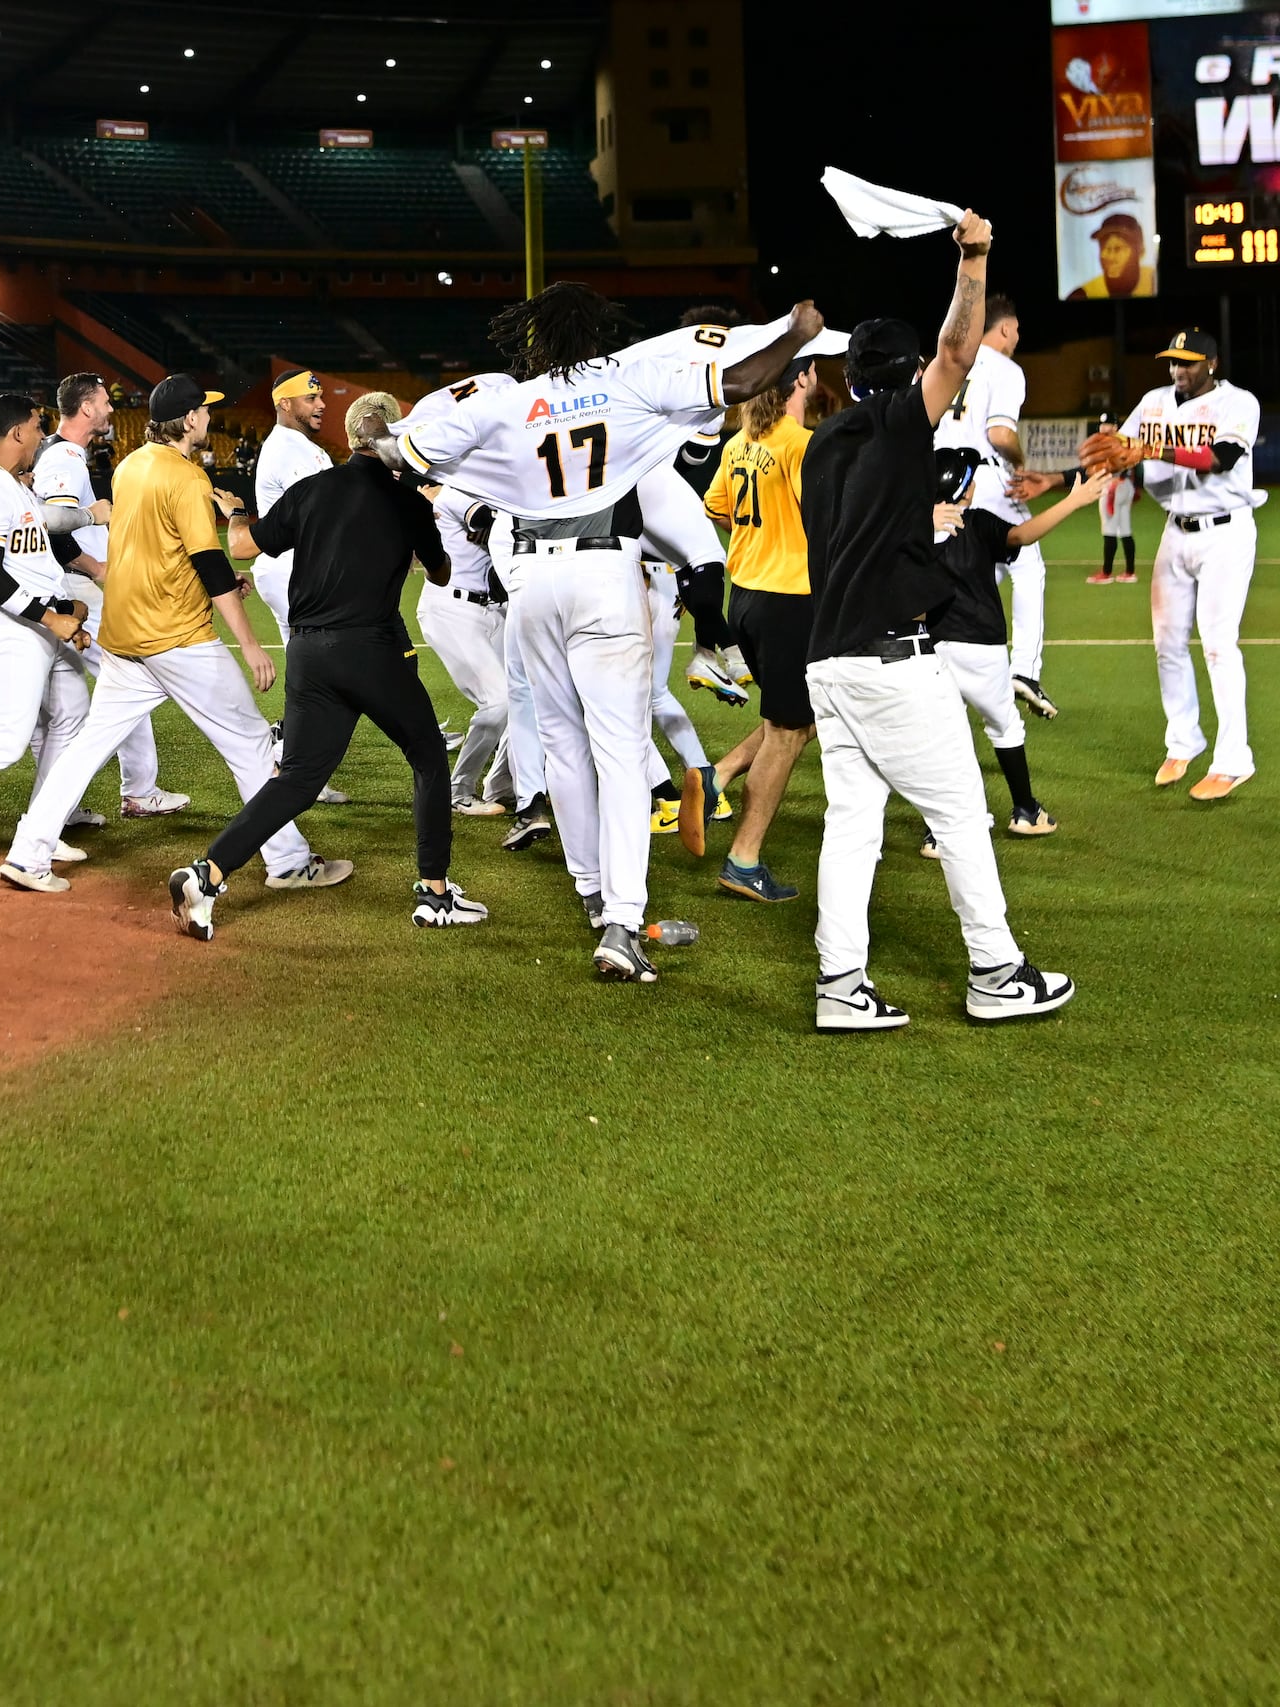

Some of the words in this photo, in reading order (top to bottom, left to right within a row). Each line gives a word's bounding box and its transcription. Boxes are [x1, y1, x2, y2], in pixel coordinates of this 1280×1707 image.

[525, 421, 542, 430] Car
[554, 415, 577, 424] Truck
[579, 408, 612, 418] Rental
[526, 393, 609, 422] ALLIED
[1027, 424, 1079, 435] Medical
[1138, 422, 1217, 448] GIGANTES
[536, 420, 609, 500] 17
[730, 467, 762, 528] 21
